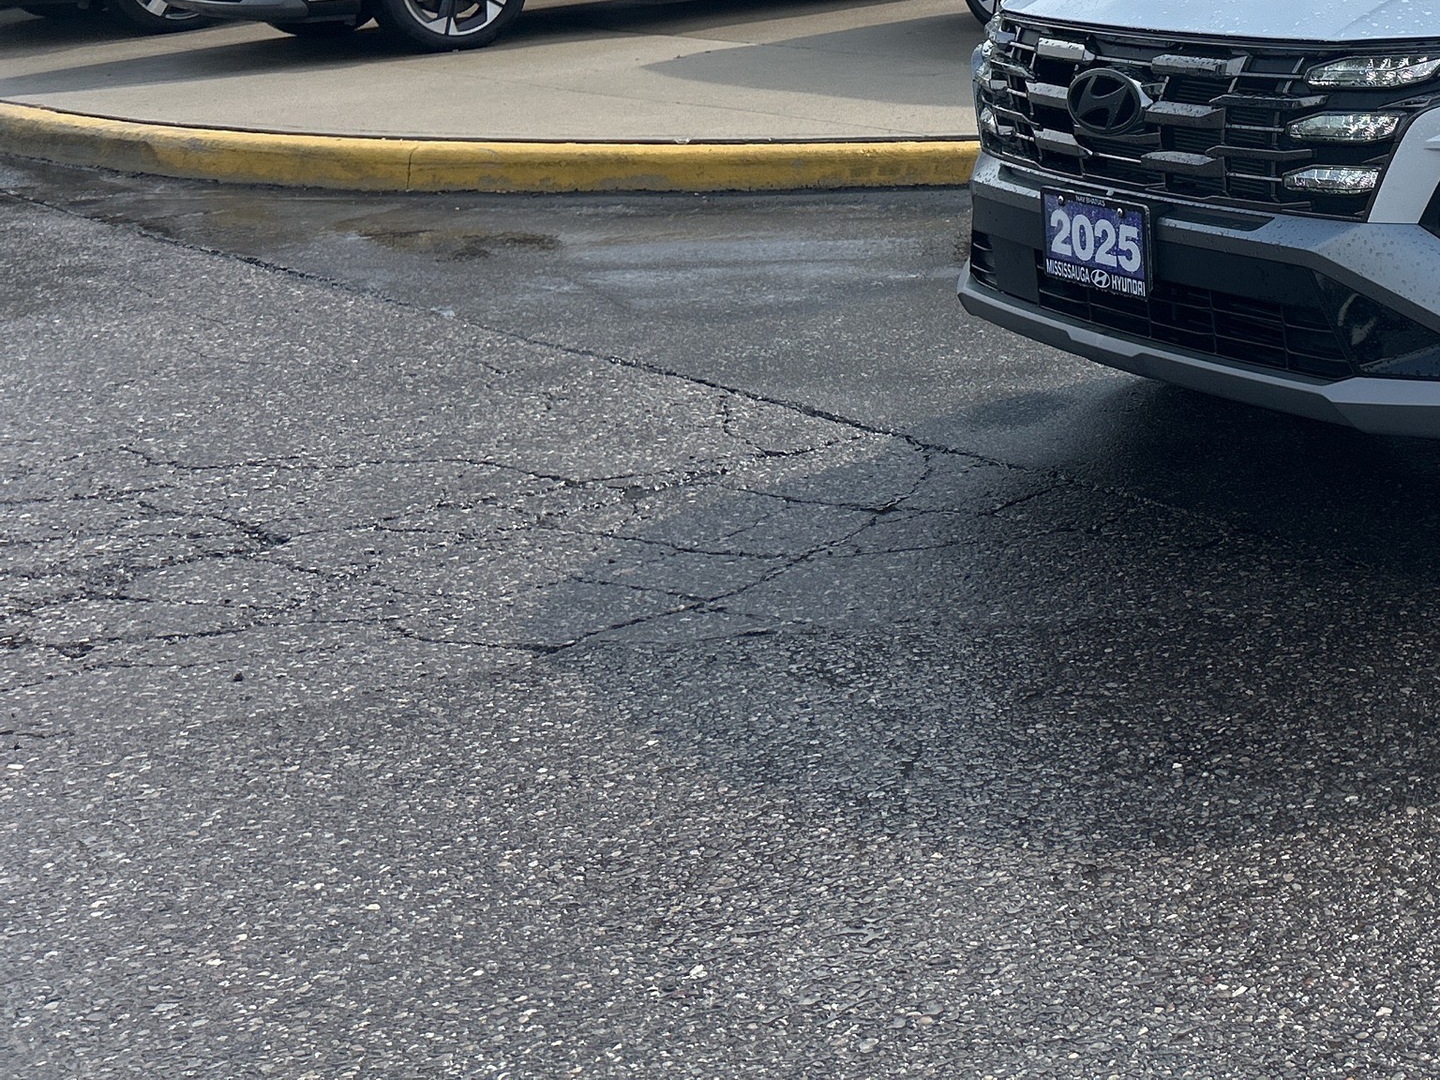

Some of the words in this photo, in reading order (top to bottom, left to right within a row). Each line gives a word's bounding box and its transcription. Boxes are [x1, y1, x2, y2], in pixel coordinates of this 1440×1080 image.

[1050, 209, 1141, 273] 2025
[1046, 259, 1090, 283] MISSISSAUGA
[1111, 275, 1146, 297] HYUNDAI
